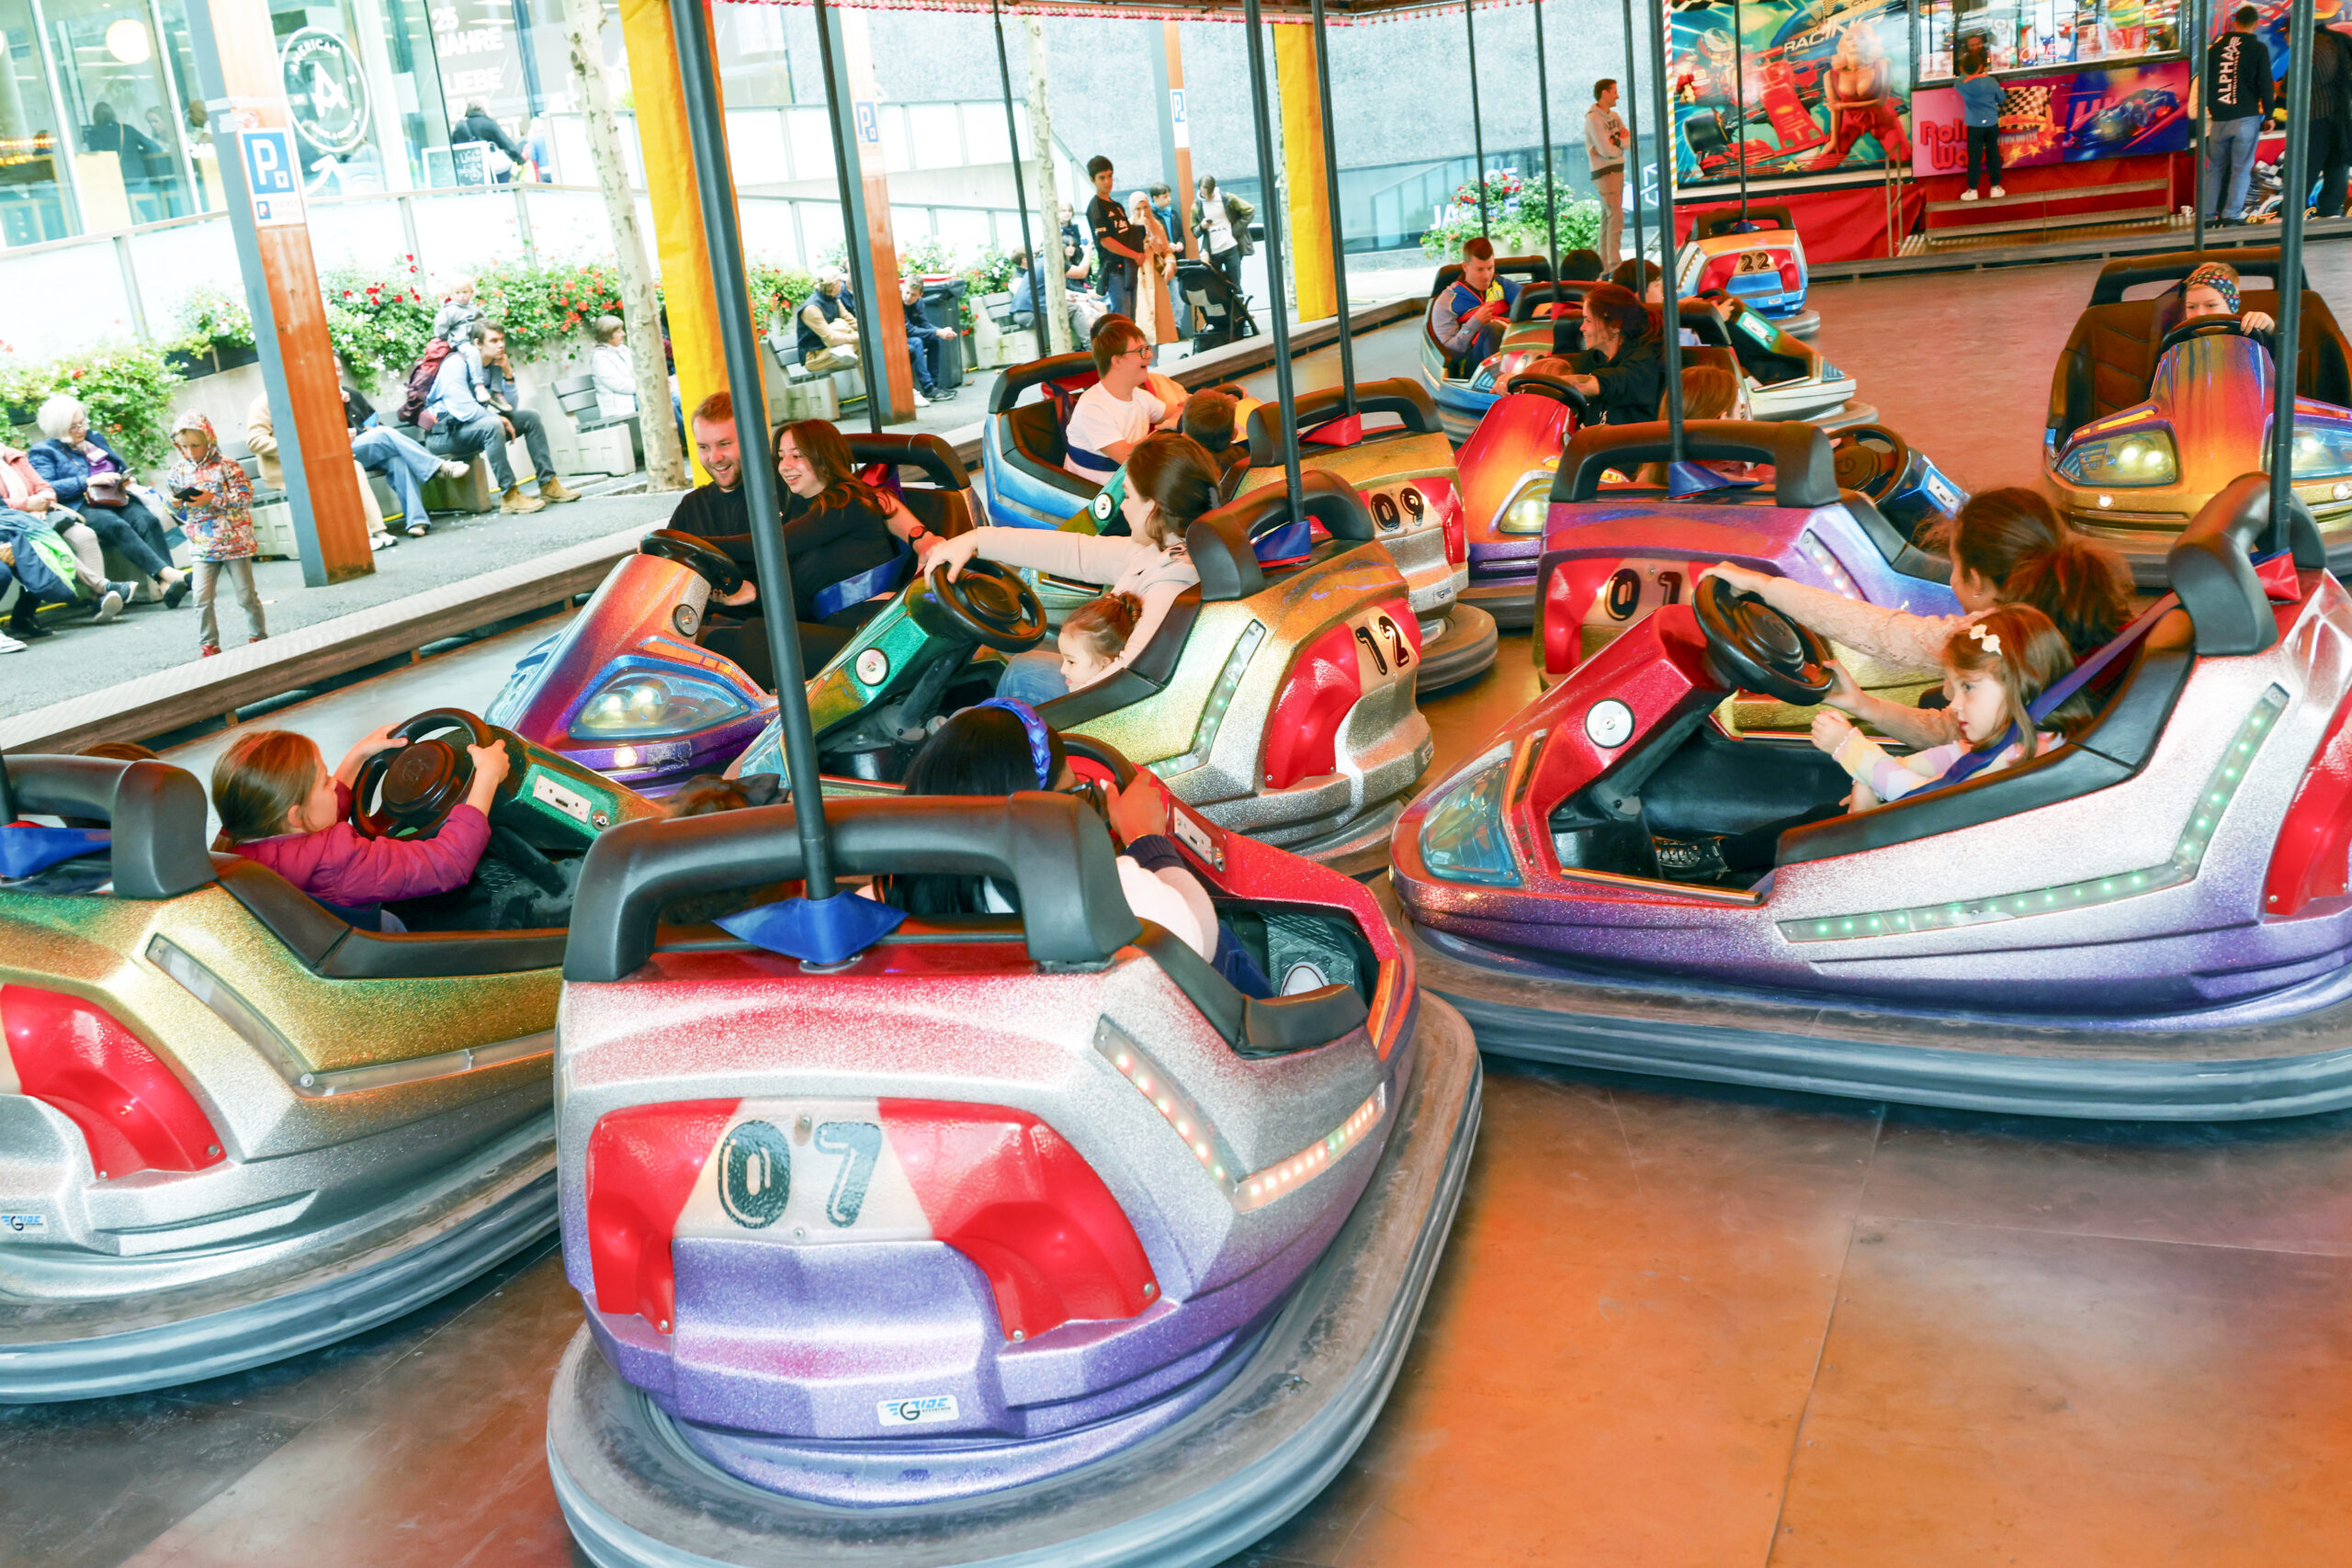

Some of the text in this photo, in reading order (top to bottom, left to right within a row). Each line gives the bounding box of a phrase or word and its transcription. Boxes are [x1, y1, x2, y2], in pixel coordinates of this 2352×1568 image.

[431, 6, 459, 32] 25
[1783, 17, 1858, 53] RACIN
[288, 39, 341, 74] AMERICAN
[438, 27, 505, 58] JAHRE
[2018, 40, 2074, 62] OPEN
[443, 67, 503, 96] LIEBE
[2217, 51, 2235, 106] ALPHA
[1920, 117, 1968, 145] Roll
[251, 139, 278, 186] P
[1739, 252, 1770, 272] 22
[1371, 487, 1425, 533] 09
[1604, 568, 1683, 622] 01
[1355, 615, 1410, 676] 12
[718, 1119, 883, 1229] 07
